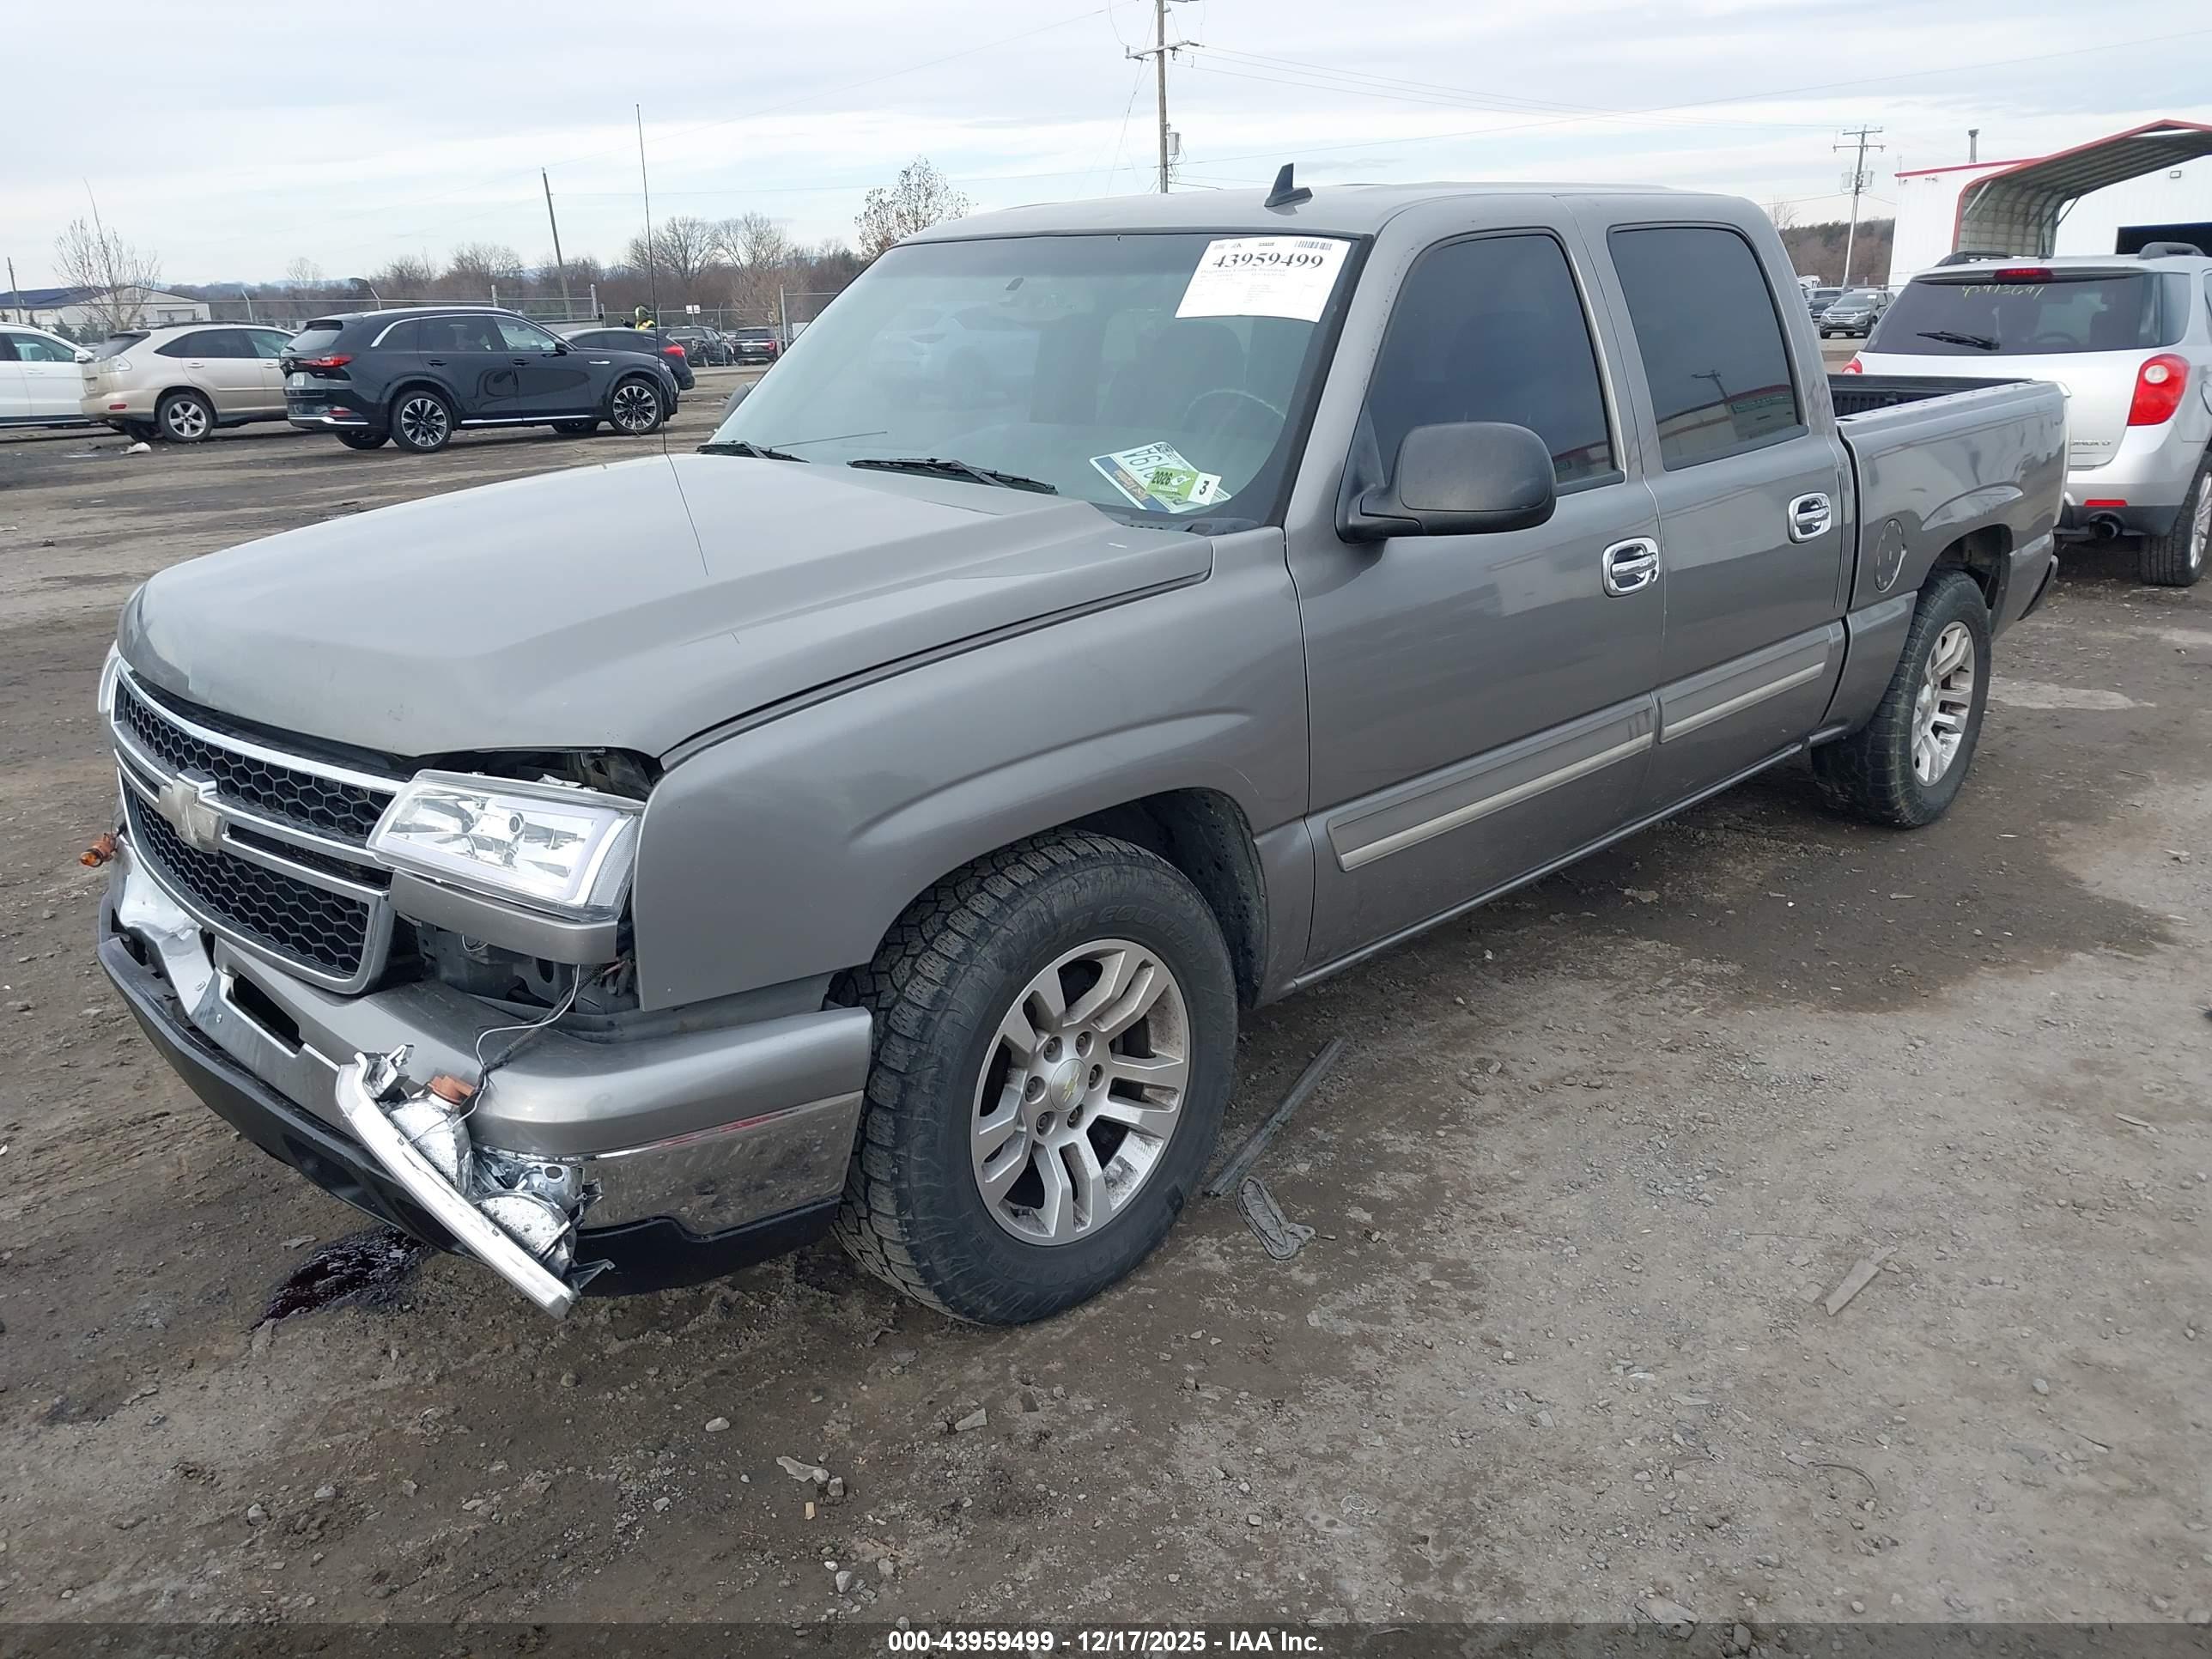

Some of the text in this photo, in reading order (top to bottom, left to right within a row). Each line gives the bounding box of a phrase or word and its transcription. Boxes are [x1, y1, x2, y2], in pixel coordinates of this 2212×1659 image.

[1212, 252, 1324, 269] 43959499
[1152, 471, 1174, 485] 2026
[1199, 480, 1210, 495] 3
